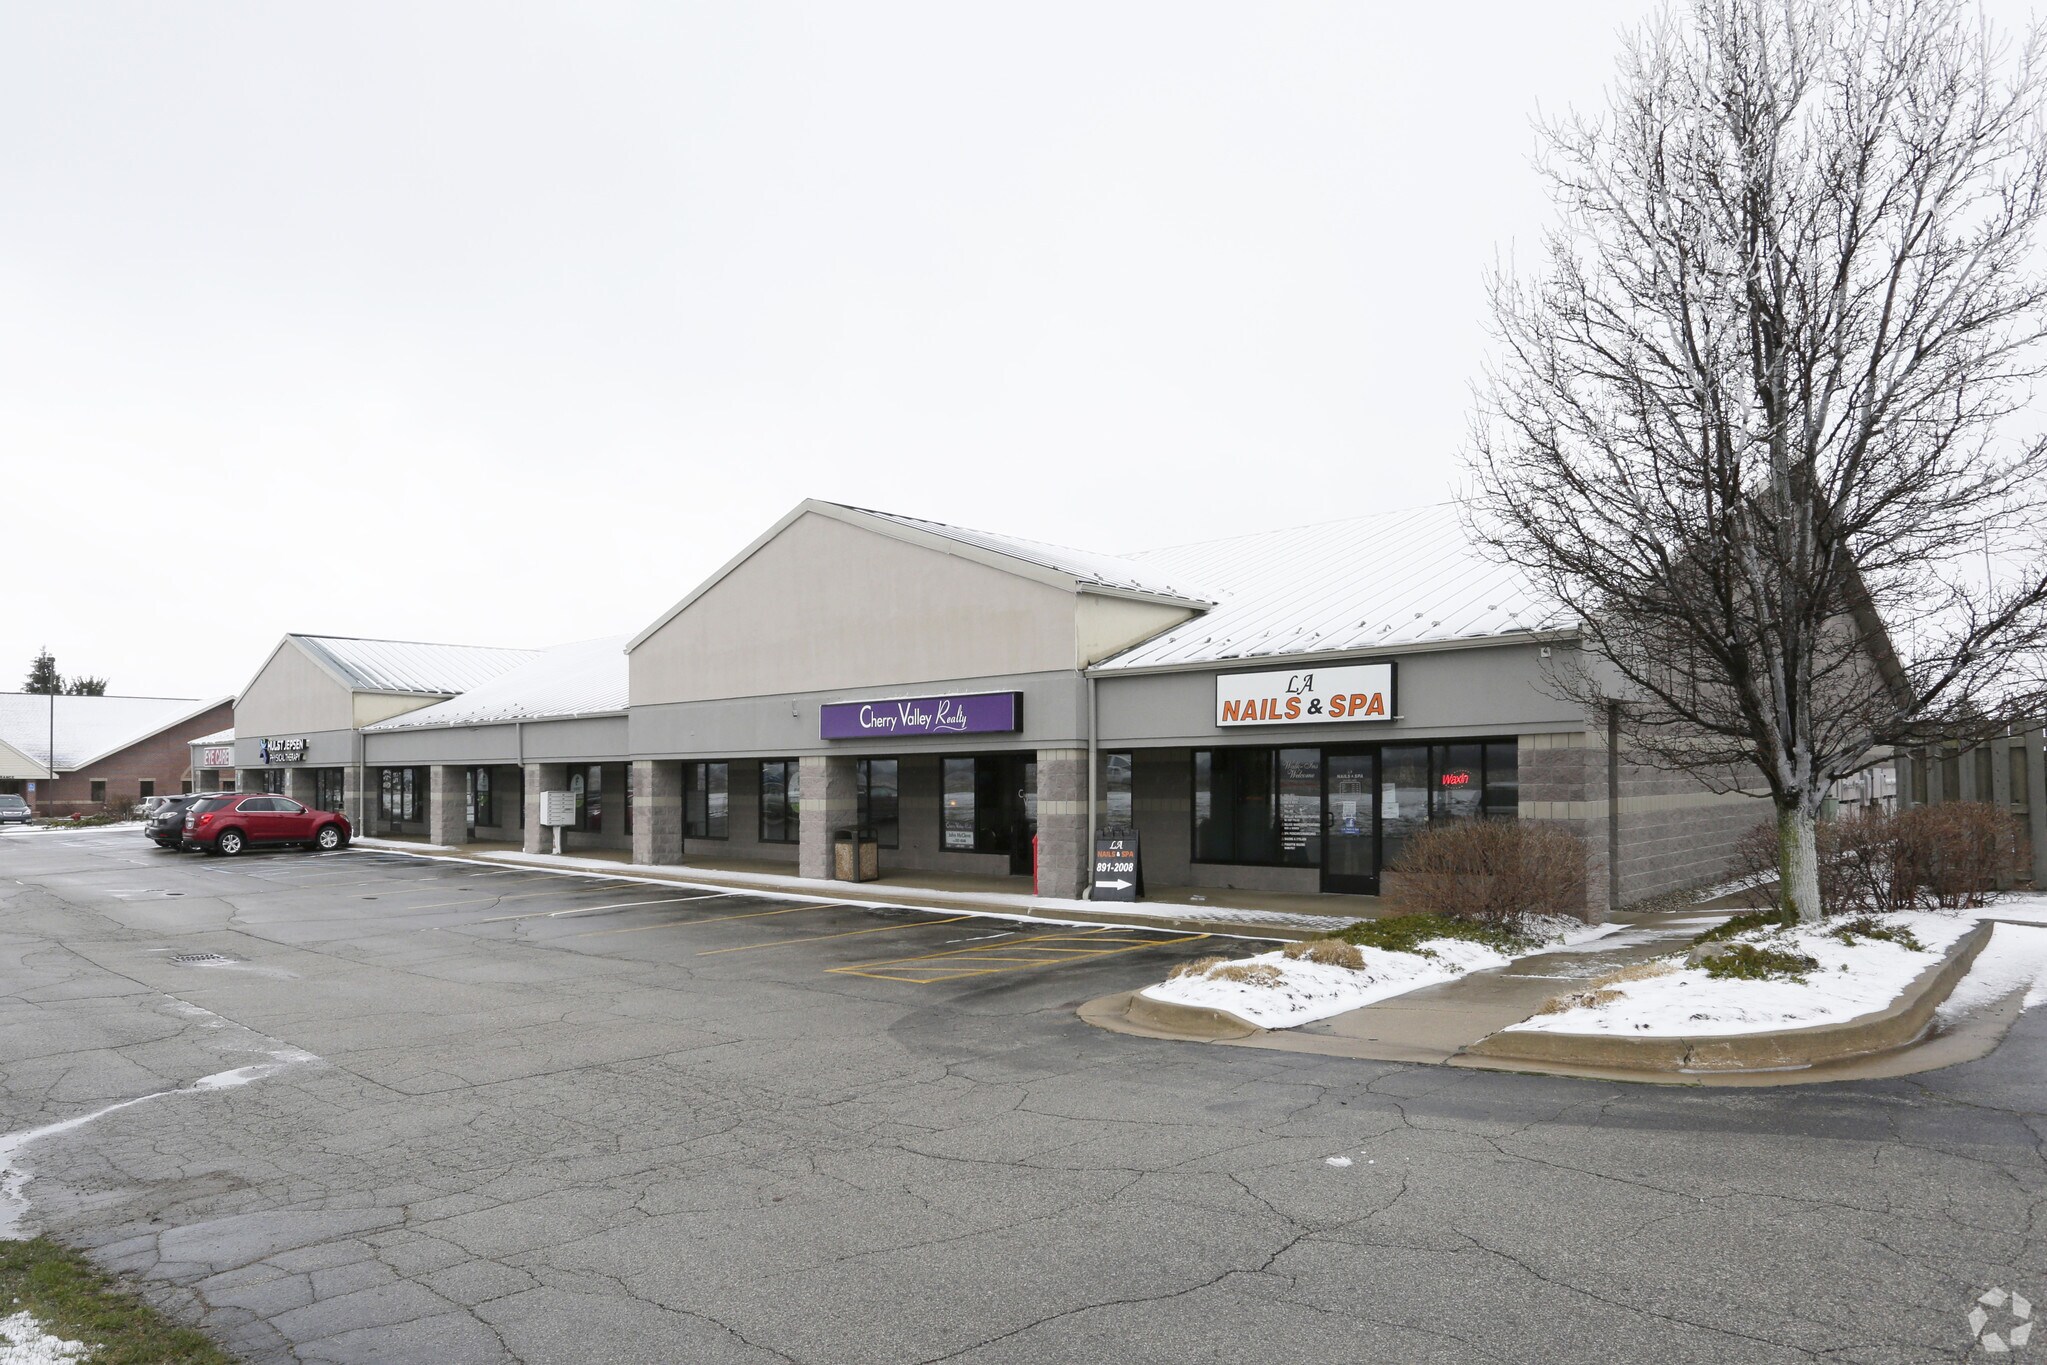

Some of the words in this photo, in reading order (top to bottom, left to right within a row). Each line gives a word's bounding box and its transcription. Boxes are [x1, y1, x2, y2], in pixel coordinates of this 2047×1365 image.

[1286, 674, 1314, 695] LA
[859, 704, 897, 732] Cherry
[898, 702, 932, 730] Valley
[934, 699, 967, 730] Realty
[1222, 697, 1301, 722] NAILS
[1307, 698, 1323, 715] &
[1328, 693, 1385, 718] SPA
[204, 750, 215, 765] EYE
[215, 748, 229, 764] CARE
[1109, 840, 1123, 849] LA
[1097, 850, 1115, 858] NAILS
[1121, 850, 1134, 858] SPA
[1096, 862, 1134, 872] 891-2008
